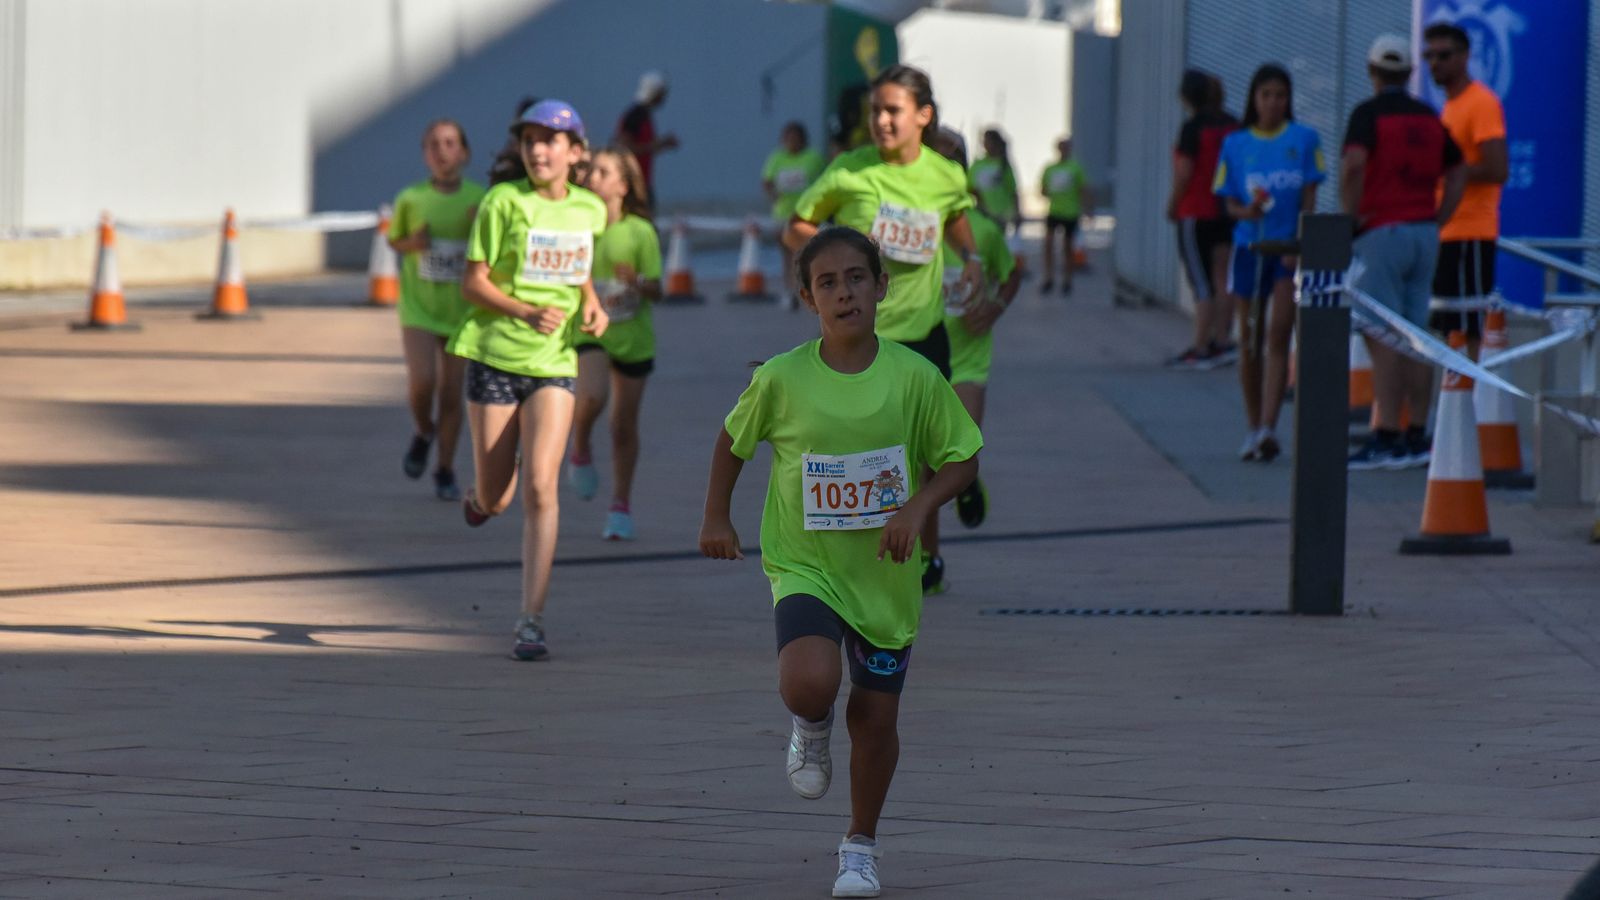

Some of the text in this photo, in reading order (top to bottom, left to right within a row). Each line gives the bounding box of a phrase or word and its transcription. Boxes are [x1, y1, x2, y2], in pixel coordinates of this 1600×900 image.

[879, 222, 923, 249] 1333
[530, 249, 575, 270] 1337
[807, 461, 826, 474] XXI
[810, 480, 874, 510] 1037
